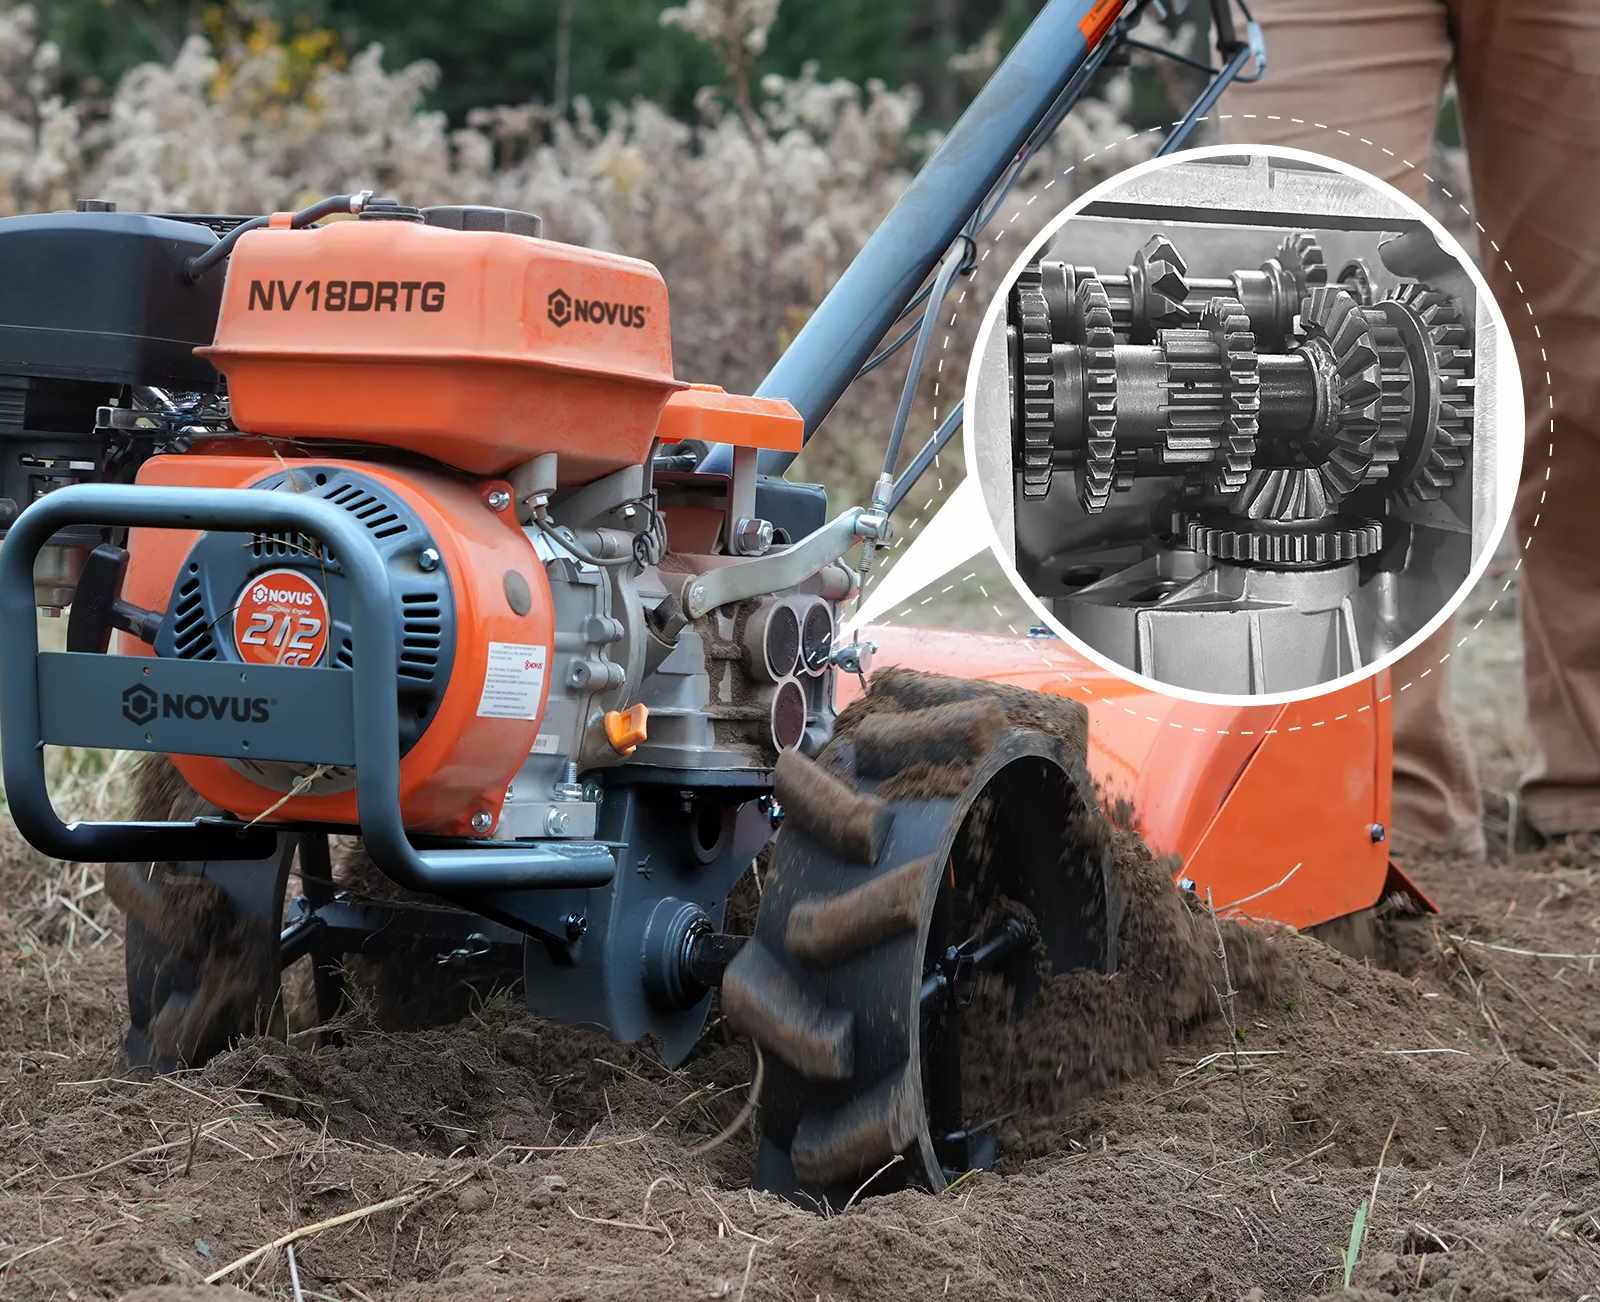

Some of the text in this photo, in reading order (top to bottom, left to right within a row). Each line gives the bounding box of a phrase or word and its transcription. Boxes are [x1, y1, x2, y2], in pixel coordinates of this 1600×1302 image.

[248, 280, 446, 312] NV18DRTG
[574, 299, 645, 329] NOVUS
[268, 589, 313, 606] NOVUS
[241, 612, 321, 650] 212
[162, 694, 269, 723] NOVUS
